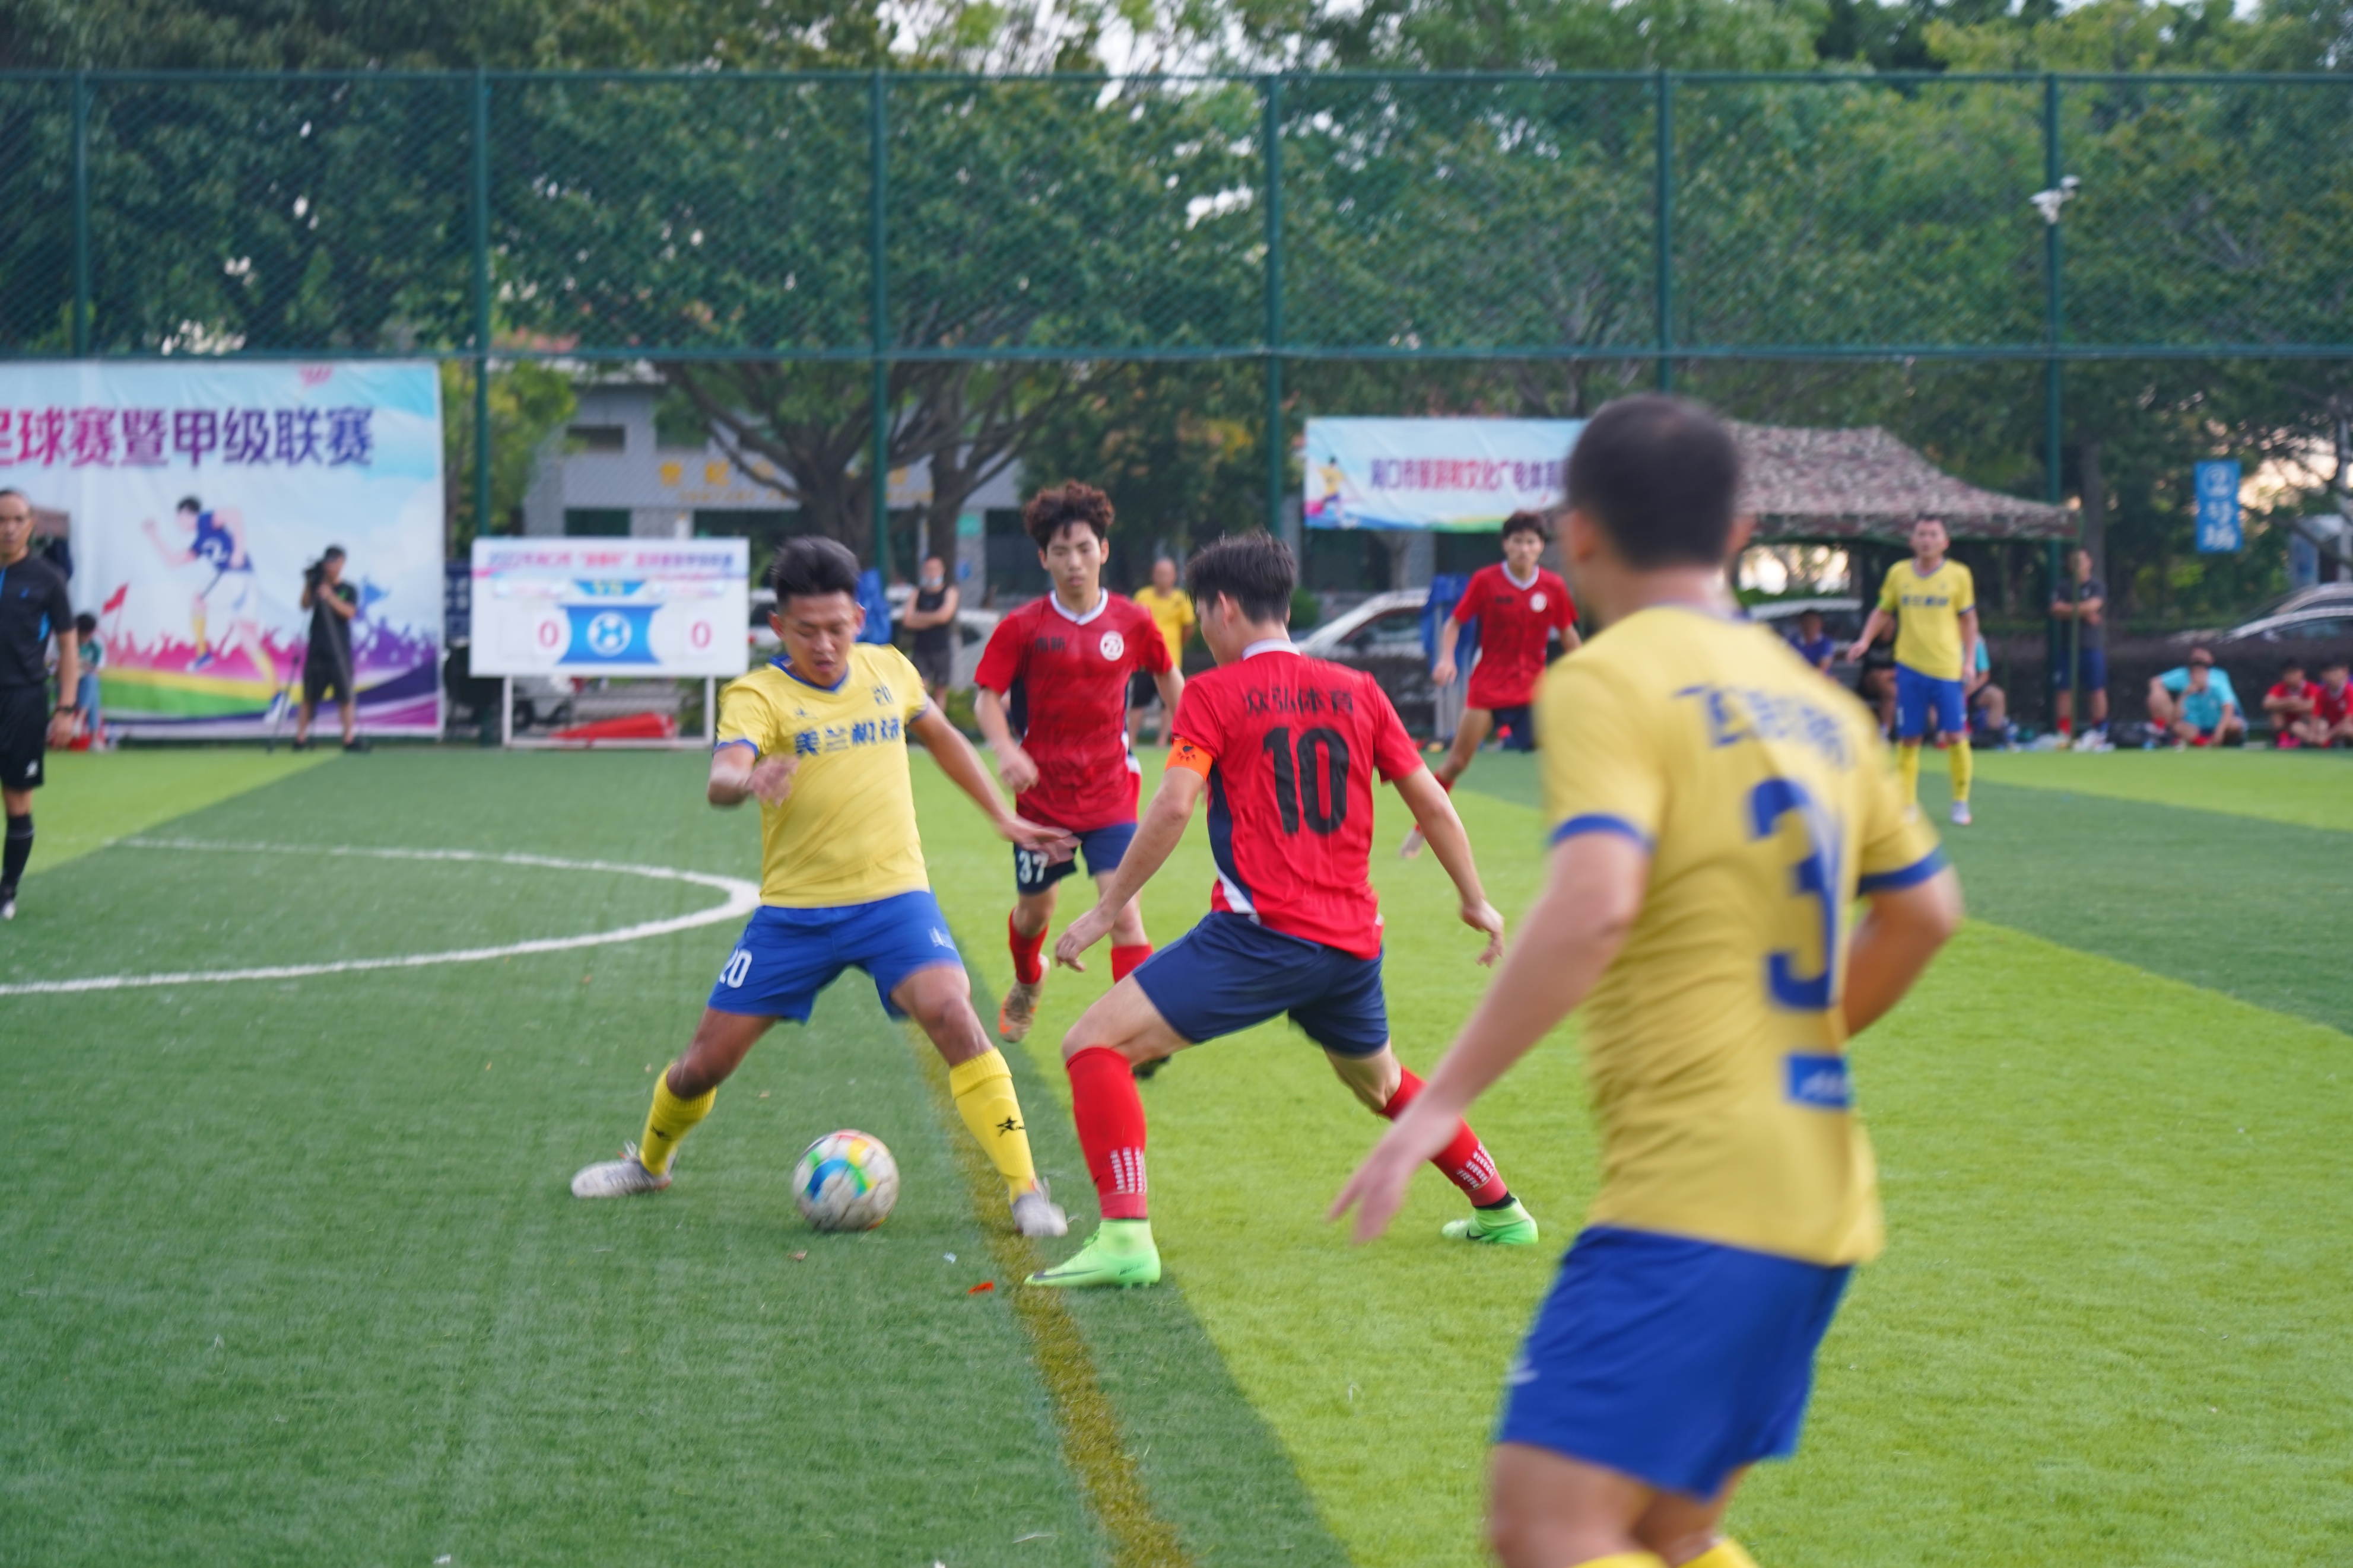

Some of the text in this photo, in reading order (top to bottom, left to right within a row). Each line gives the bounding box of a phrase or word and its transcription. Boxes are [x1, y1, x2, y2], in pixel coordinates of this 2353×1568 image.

[538, 621, 559, 648] 0
[691, 621, 712, 648] 0
[1263, 727, 1350, 836] 10
[1018, 850, 1049, 885] 37
[1746, 777, 1841, 1011] 3
[719, 947, 752, 988] 20
